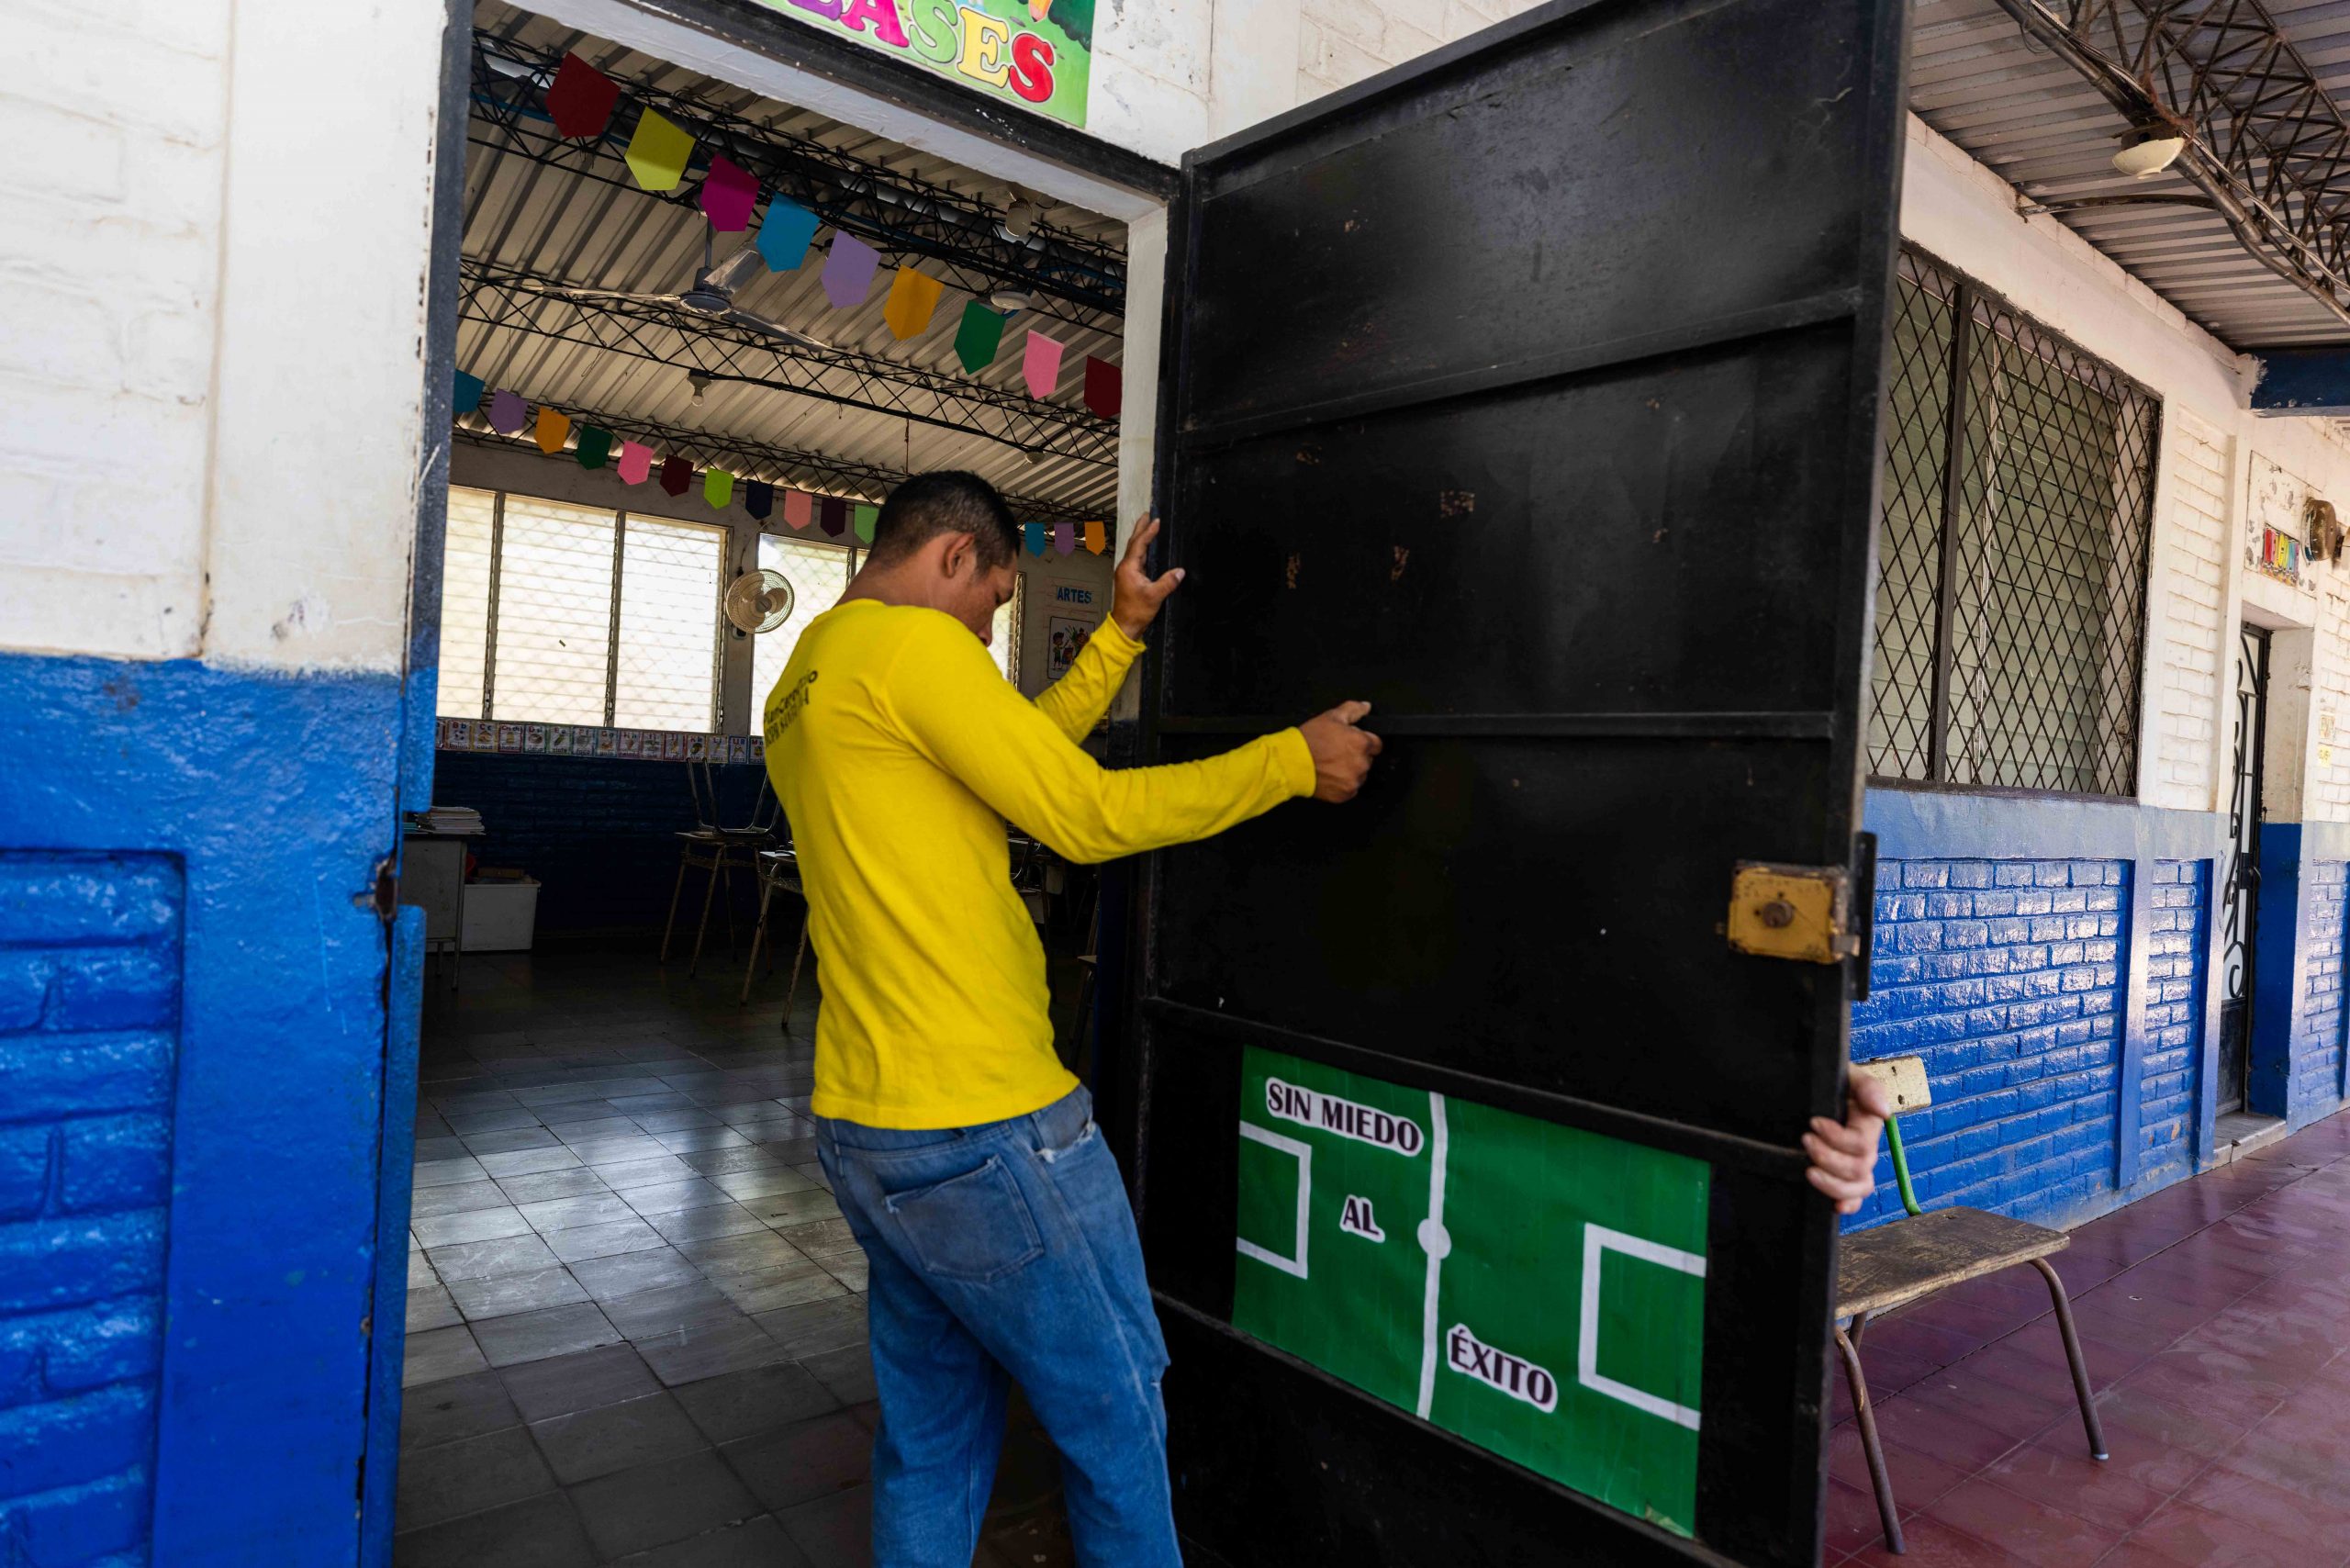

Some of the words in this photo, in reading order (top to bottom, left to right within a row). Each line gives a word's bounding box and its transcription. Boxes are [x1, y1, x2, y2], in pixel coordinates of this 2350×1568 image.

[1058, 587, 1091, 604] ARTES
[1268, 1082, 1312, 1122] SIN
[1321, 1098, 1420, 1152] MIEDO
[1342, 1198, 1380, 1235] AL
[1450, 1328, 1553, 1406] ÉXITO
